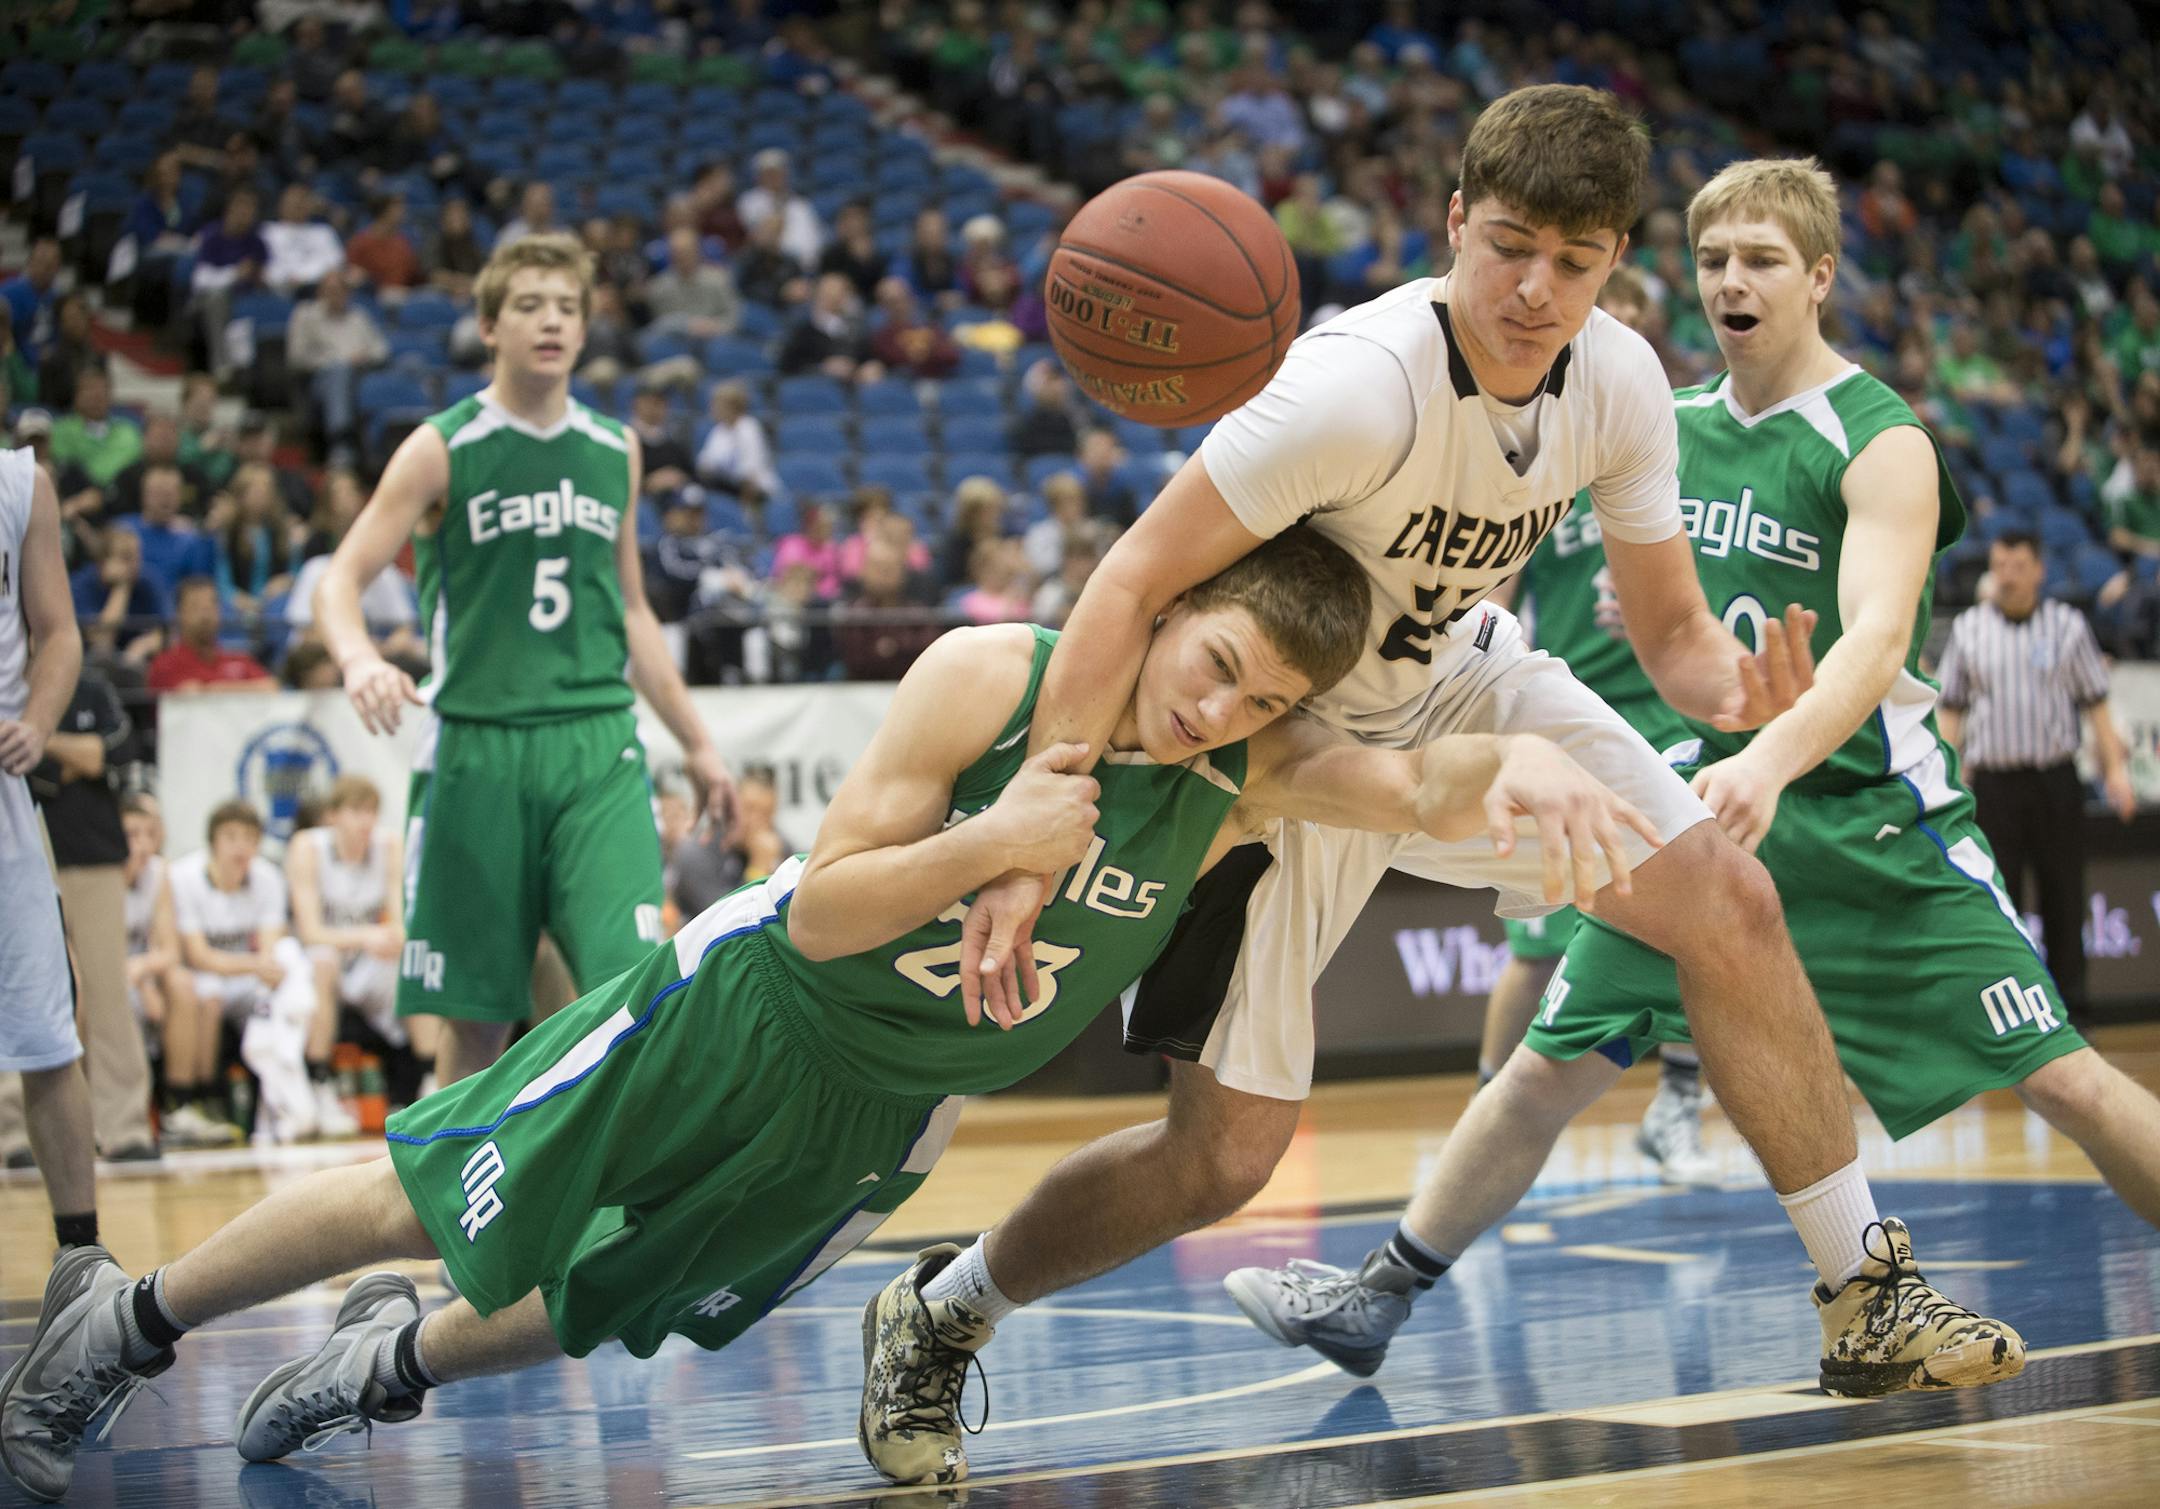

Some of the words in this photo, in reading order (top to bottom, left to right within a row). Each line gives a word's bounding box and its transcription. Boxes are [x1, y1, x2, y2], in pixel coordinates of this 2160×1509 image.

[467, 478, 619, 544] Eagles
[1679, 487, 1820, 571] agles
[528, 556, 571, 632] 5
[1980, 975, 2061, 1036] MR
[459, 1140, 506, 1244] MR
